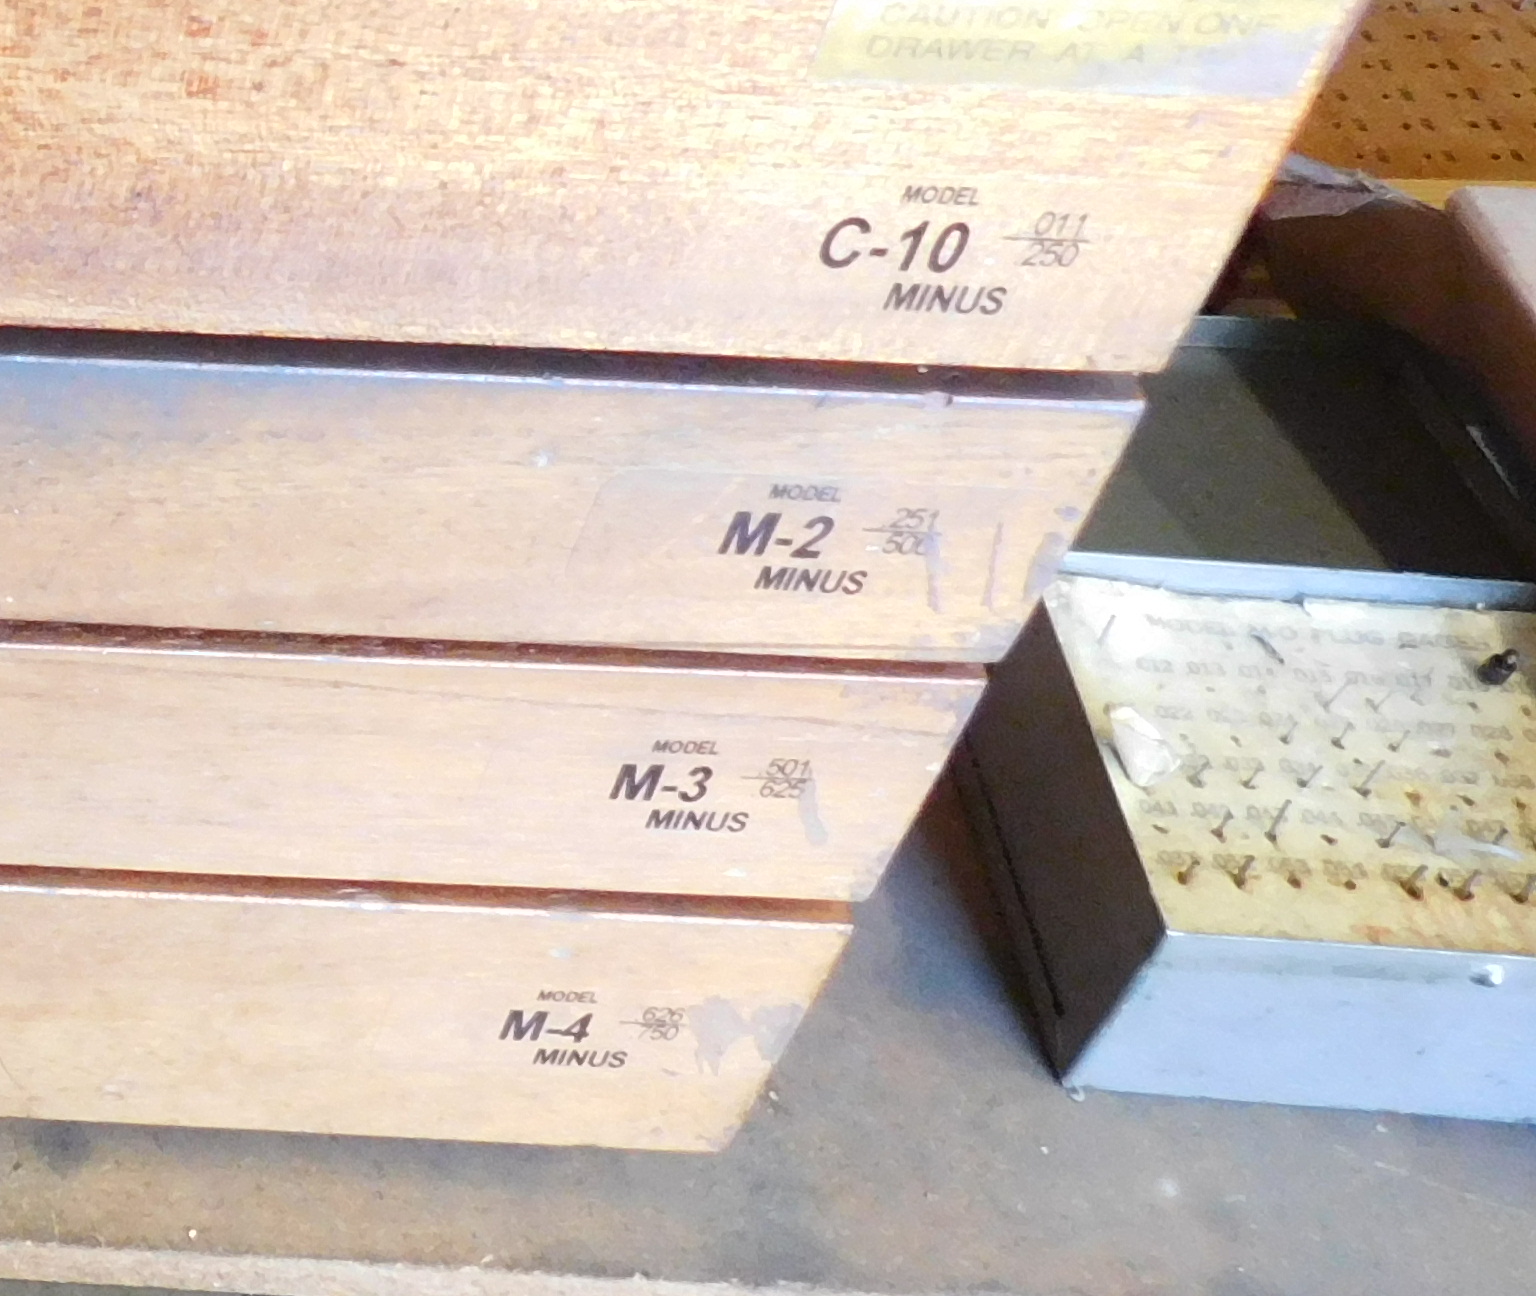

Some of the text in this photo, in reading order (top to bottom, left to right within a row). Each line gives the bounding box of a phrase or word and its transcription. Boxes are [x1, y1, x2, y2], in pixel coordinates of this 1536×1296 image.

[879, 1, 1053, 31] CAUTION
[865, 33, 1036, 63] DRAWER
[902, 185, 980, 207] MODEL
[818, 216, 971, 273] C-10
[883, 282, 1008, 316] MINUS
[769, 484, 842, 503] MODEL
[717, 510, 836, 560] M-2
[754, 565, 868, 596] MINUS
[651, 739, 719, 756] MODEL
[609, 763, 714, 804] M-3
[645, 808, 750, 833] MINUS
[536, 989, 599, 1004] MODEL
[499, 1008, 594, 1044] M-4
[532, 1047, 628, 1069] MINUS
